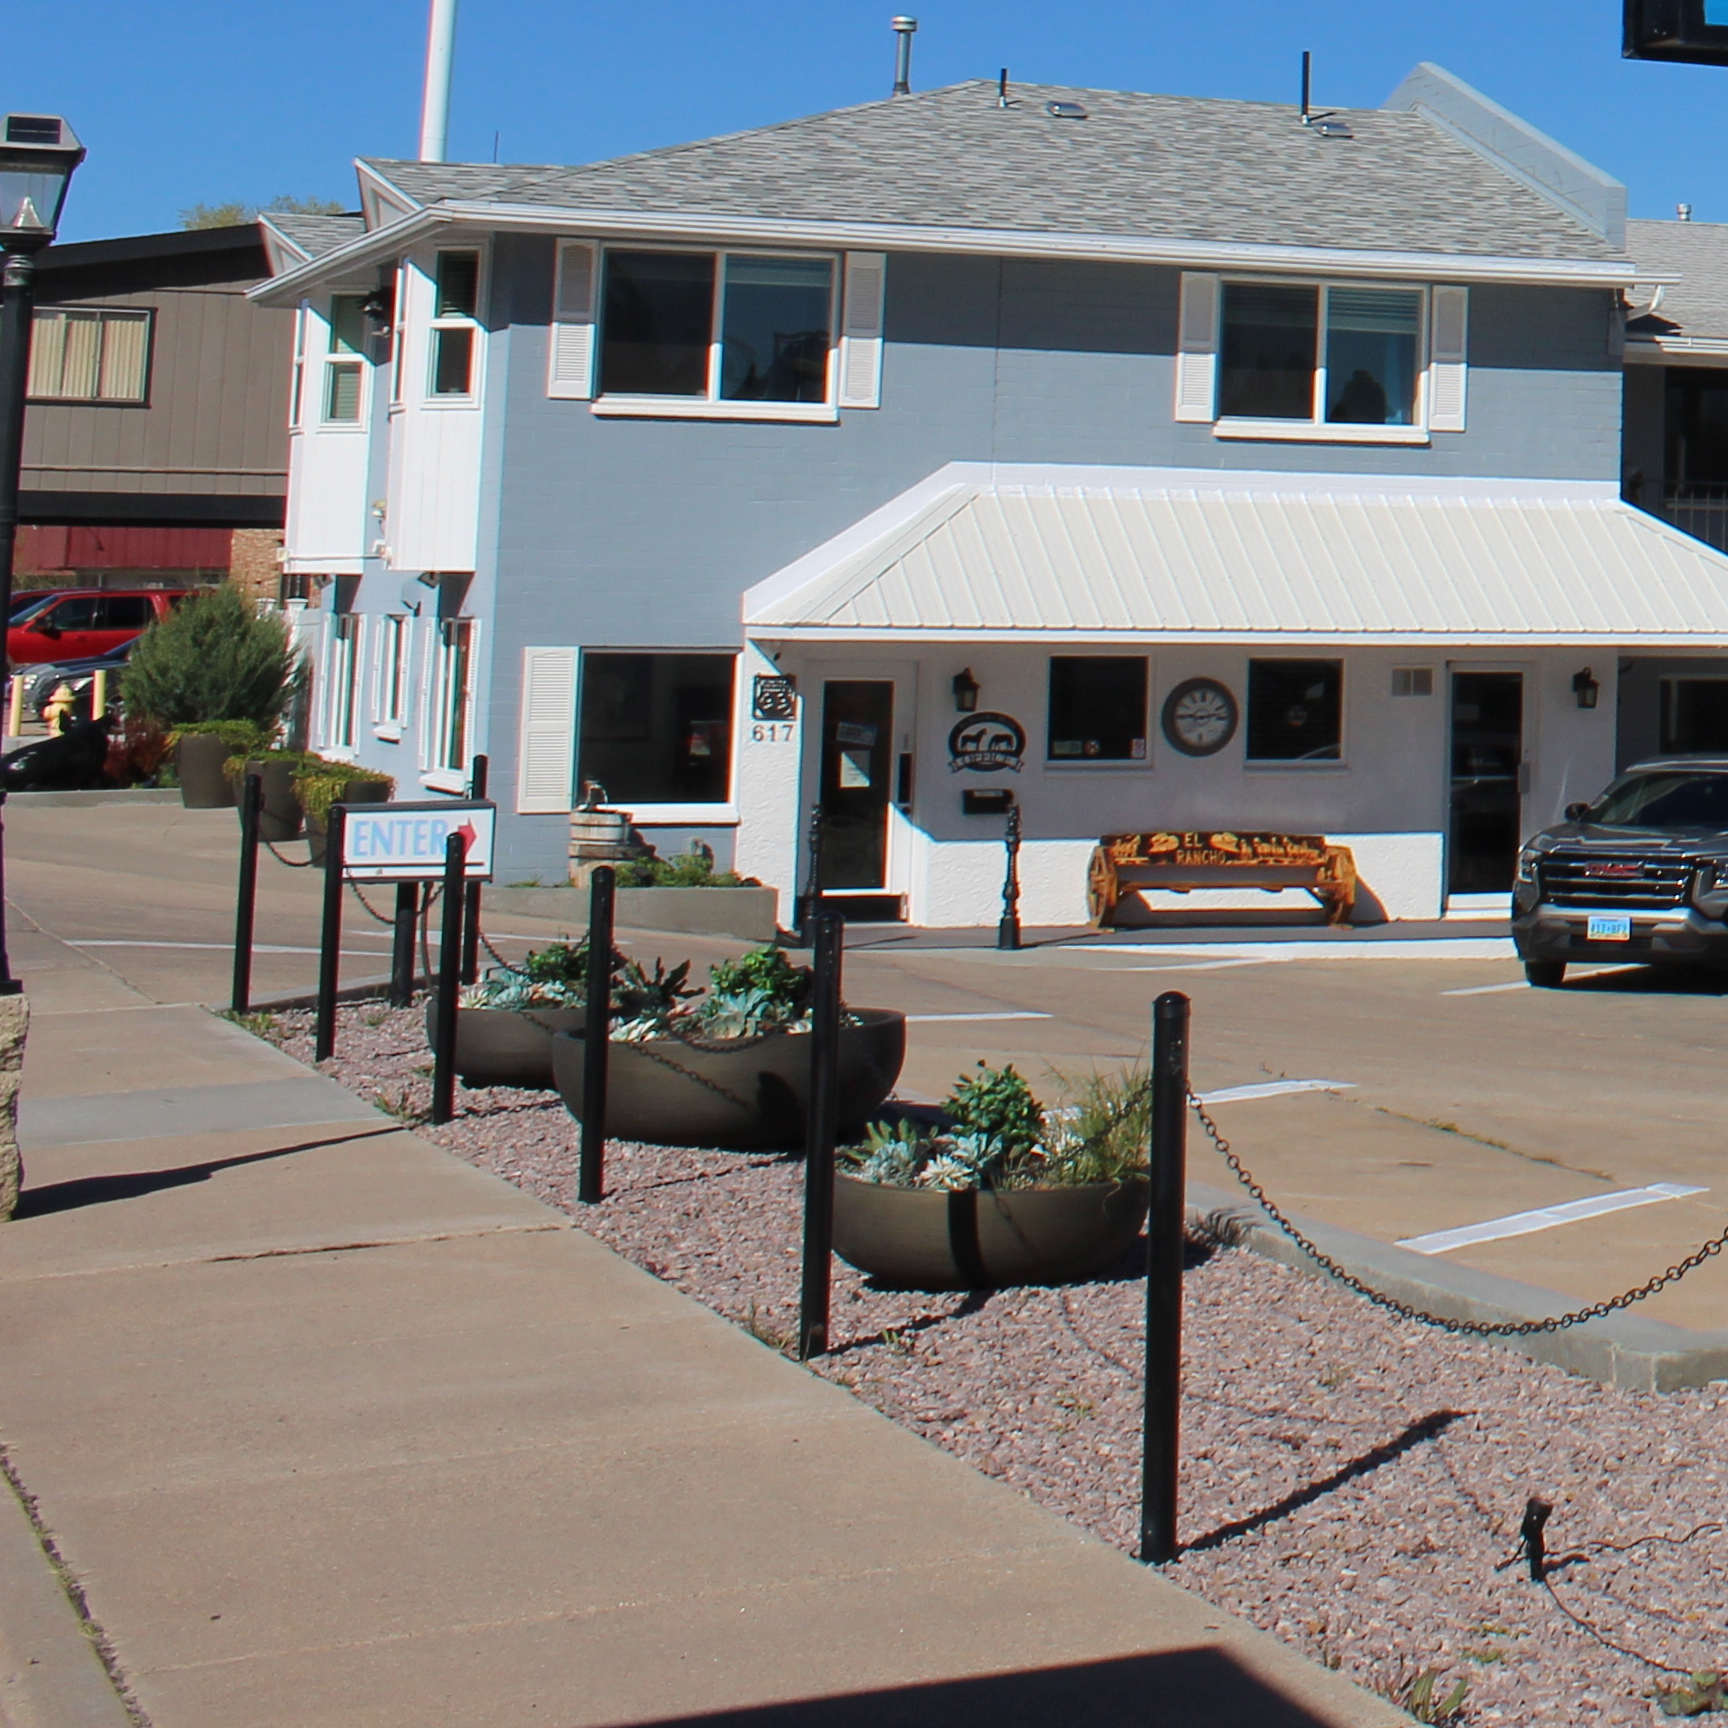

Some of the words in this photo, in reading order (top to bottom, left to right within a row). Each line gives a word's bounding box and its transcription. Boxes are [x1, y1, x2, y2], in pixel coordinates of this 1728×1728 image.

[752, 724, 794, 742] 617
[354, 819, 449, 856] ENTER
[1184, 833, 1203, 847] EL
[1175, 849, 1226, 864] RANCHO
